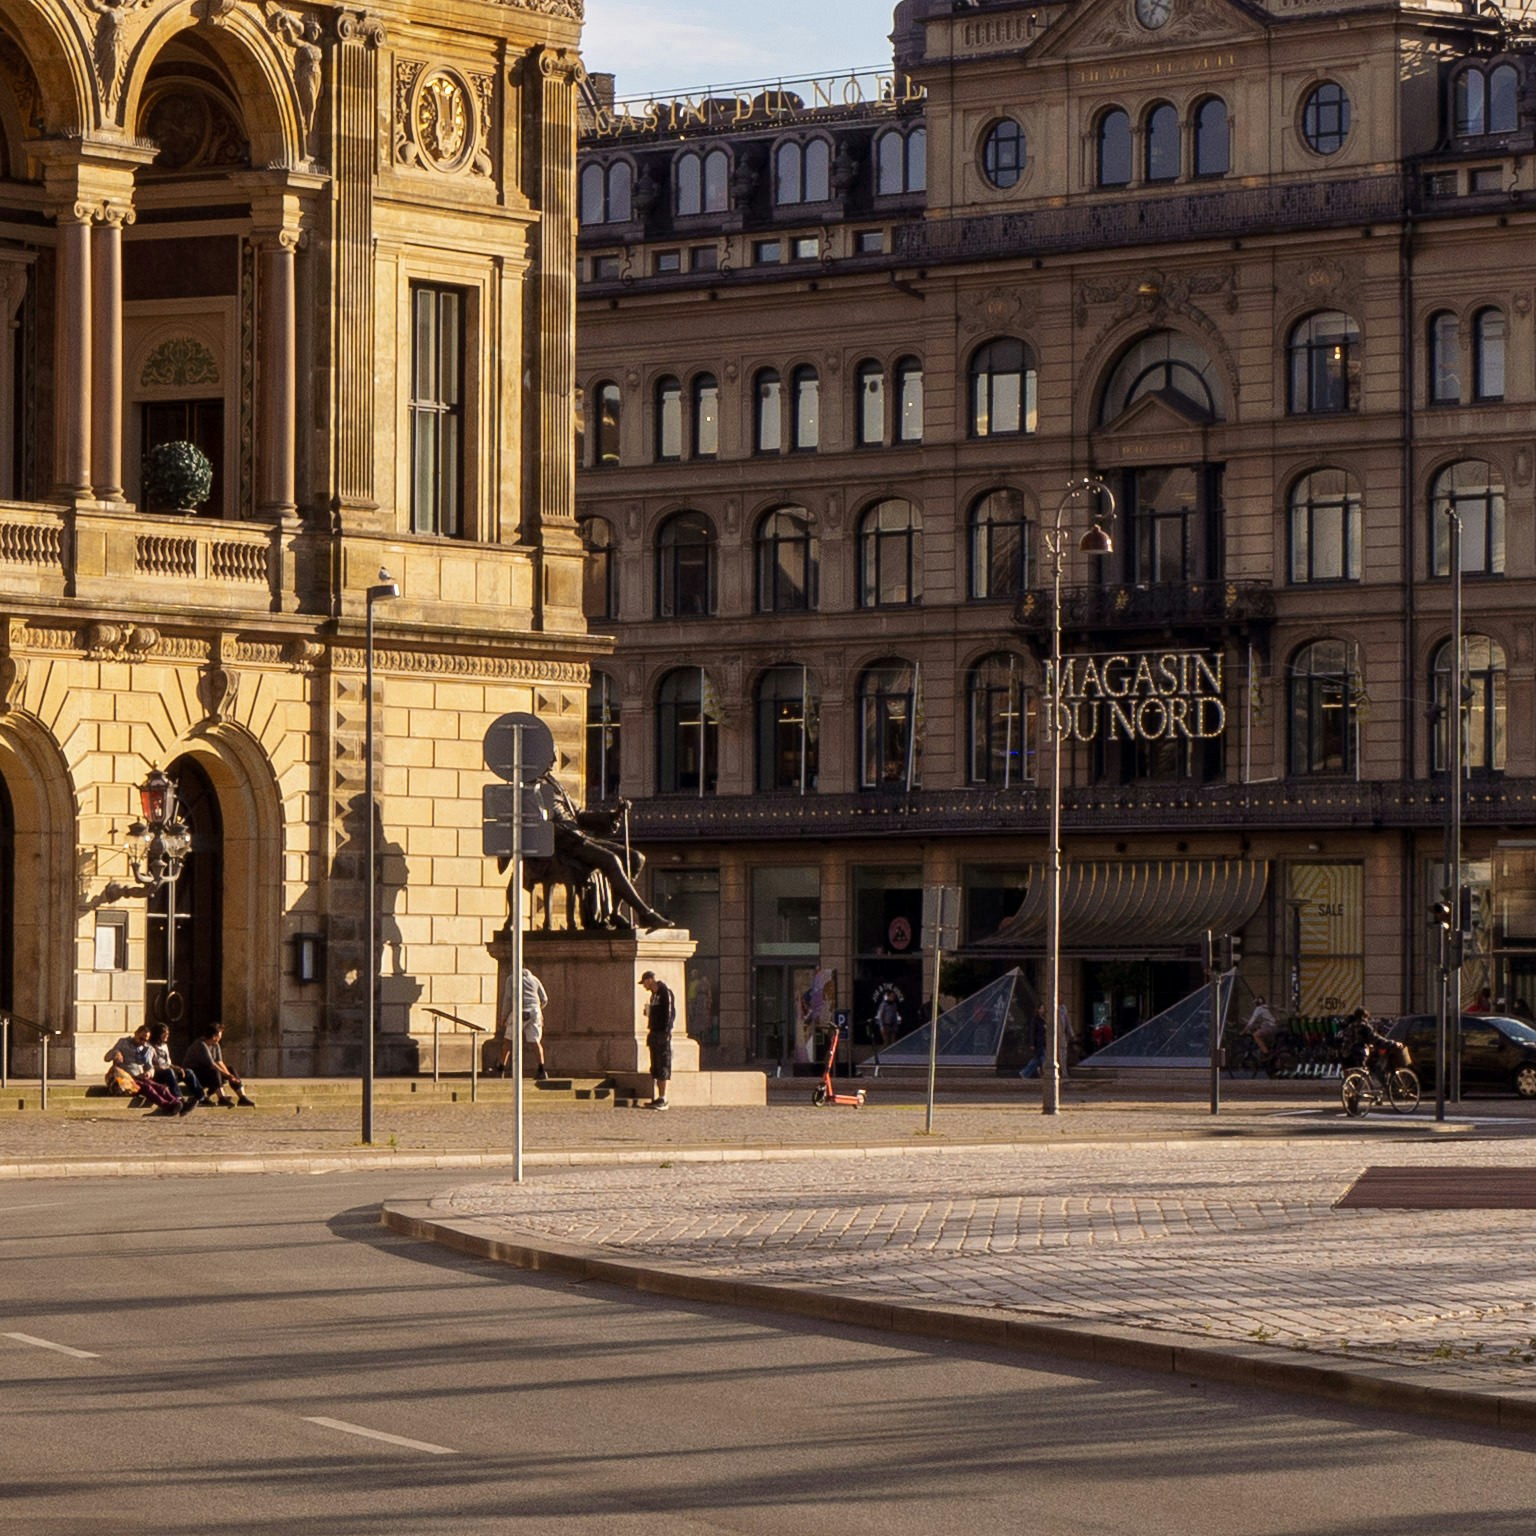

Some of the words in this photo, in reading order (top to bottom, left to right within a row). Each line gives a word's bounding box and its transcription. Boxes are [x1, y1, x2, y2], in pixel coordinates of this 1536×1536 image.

[731, 86, 783, 126] DU
[1042, 652, 1225, 700] MAGASIN
[1042, 699, 1101, 743] DU
[1106, 696, 1226, 741] NORD
[1318, 903, 1344, 917] SALE
